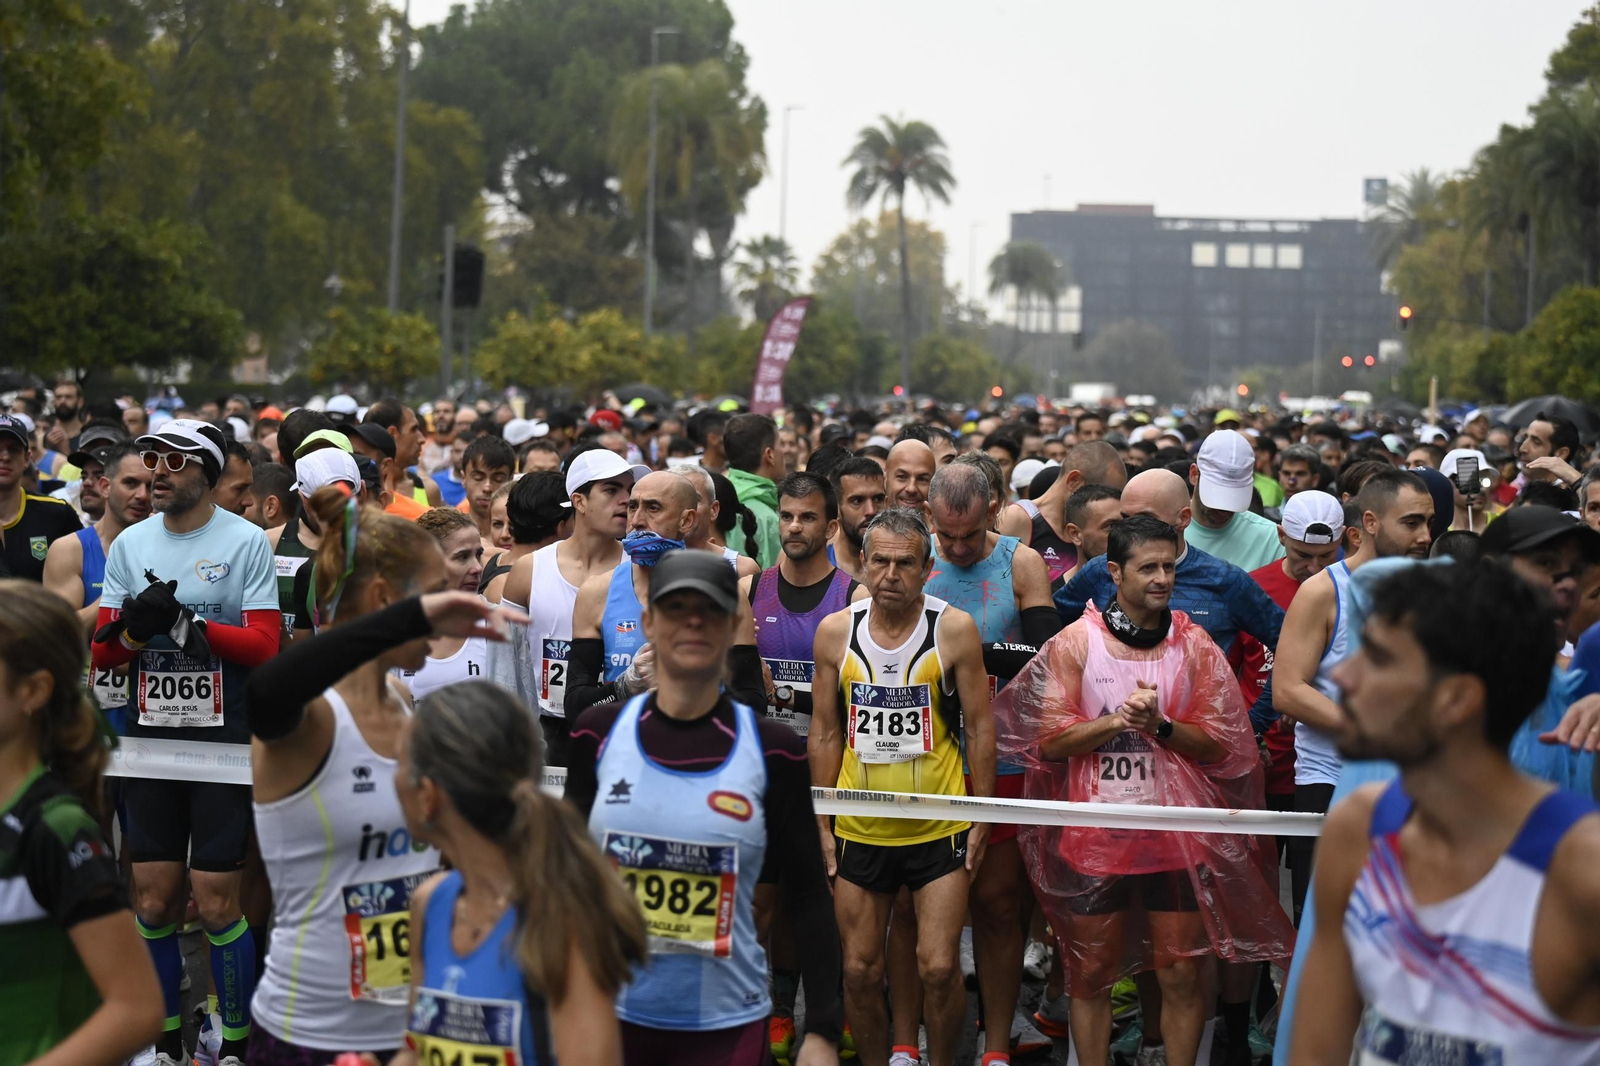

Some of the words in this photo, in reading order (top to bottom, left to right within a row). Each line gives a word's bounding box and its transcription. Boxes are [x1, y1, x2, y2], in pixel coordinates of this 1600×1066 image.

[778, 661, 805, 671] MEDIA
[147, 675, 212, 700] 2066
[885, 687, 913, 696] MEDIA
[857, 692, 872, 705] 59
[856, 709, 921, 736] 2183
